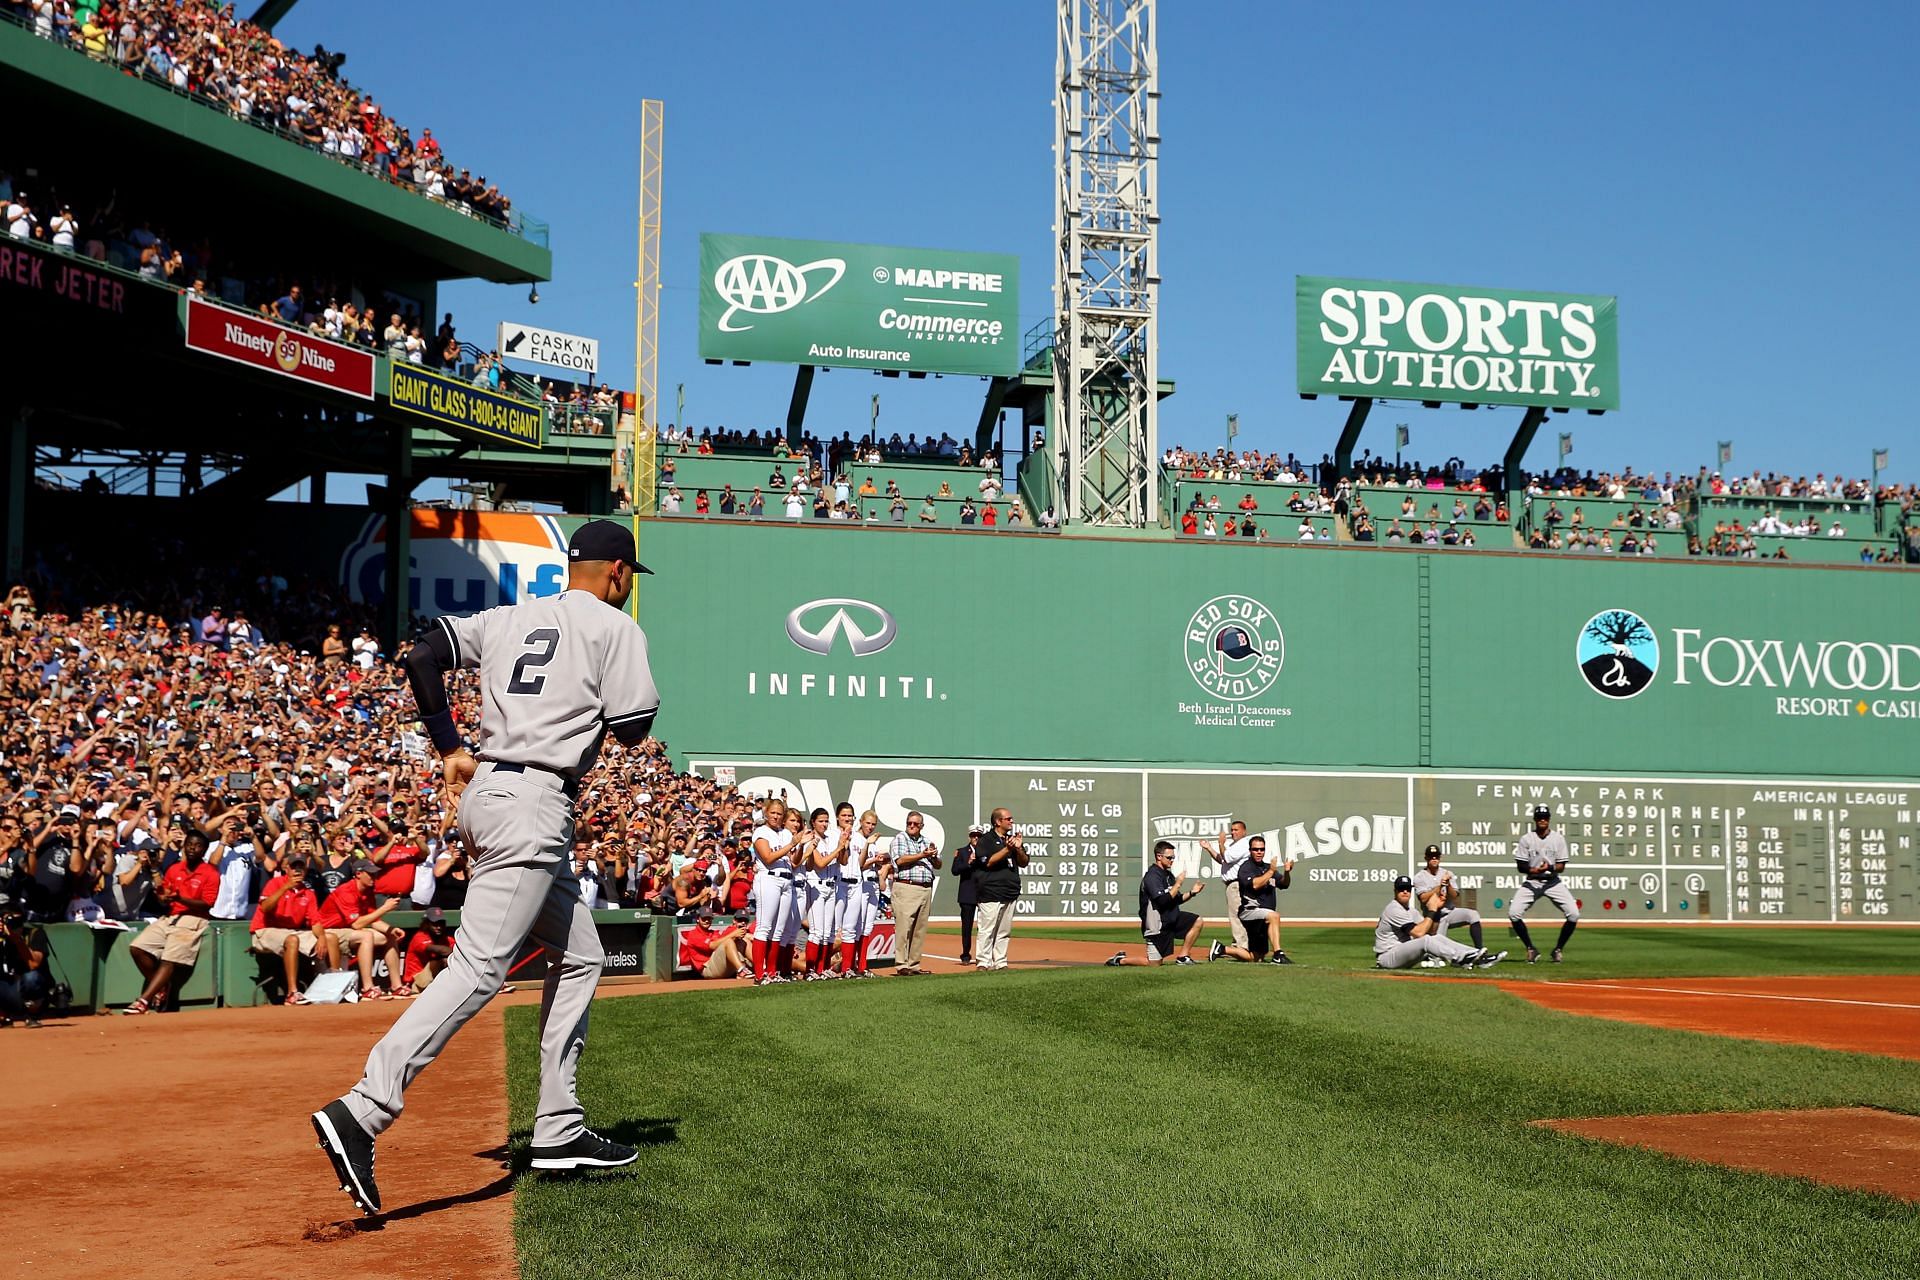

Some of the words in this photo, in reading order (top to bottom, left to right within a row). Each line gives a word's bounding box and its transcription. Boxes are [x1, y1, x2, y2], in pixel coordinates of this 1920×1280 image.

[722, 256, 800, 312] AAA
[895, 267, 1002, 293] MAPFRE
[55, 265, 124, 313] JETER
[879, 308, 1003, 336] Commerce
[1320, 287, 1597, 360] SPORTS
[531, 332, 573, 353] CASK
[907, 332, 998, 345] INSURANCE
[225, 323, 275, 357] Ninety
[302, 346, 335, 372] Nine
[809, 343, 843, 357] Auto
[846, 345, 911, 362] Insurance
[531, 347, 594, 371] FLAGON
[1321, 348, 1596, 396] AUTHORITY
[394, 372, 429, 405] GIANT
[430, 382, 467, 421] GLASS
[468, 398, 508, 431] 1-800-54
[509, 409, 539, 441] GIANT
[1189, 604, 1222, 644] RED
[1228, 599, 1267, 627] SOX
[504, 626, 562, 697] 2
[1193, 639, 1280, 696] SCHOLARS
[749, 672, 933, 699] INFINITI
[1178, 702, 1201, 713] Beth
[1205, 703, 1234, 714] Israel
[1237, 704, 1292, 716] Deaconess
[1776, 697, 1852, 716] RESORT
[1871, 700, 1920, 718] CASI
[1195, 715, 1237, 726] Medical
[1240, 716, 1276, 727] Center
[1028, 778, 1048, 791] AL
[1057, 779, 1095, 792] EAST
[1477, 784, 1579, 799] FENWAY
[1599, 787, 1664, 800] PARK
[1752, 790, 1837, 804] AMERICAN
[1845, 792, 1908, 805] LEAGUE
[1058, 803, 1077, 817] W
[1085, 804, 1094, 817] L
[1101, 804, 1122, 817] GB
[1441, 802, 1451, 815] P
[1644, 805, 1658, 819] 10
[1736, 807, 1746, 820] P
[1794, 808, 1808, 821] IN
[1813, 809, 1823, 821] R
[1839, 808, 1849, 822] P
[1897, 810, 1911, 823] IN
[1059, 824, 1077, 837] 95
[1081, 824, 1098, 838] 66
[1153, 818, 1195, 836] WHO
[1198, 817, 1231, 836] BUT
[1439, 822, 1453, 835] 35
[1472, 822, 1492, 835] NY
[1735, 826, 1748, 839] 53
[1761, 827, 1780, 840] TB
[1861, 829, 1885, 841] LAA
[1024, 843, 1048, 856] ORK
[1059, 843, 1077, 856] 83
[1081, 843, 1098, 857] 78
[1105, 844, 1119, 857] 12
[1457, 841, 1507, 855] BOSTON
[1758, 842, 1785, 854] CLE
[1861, 843, 1886, 855] SEA
[1059, 862, 1077, 876] 83
[1081, 862, 1098, 876] 78
[1105, 863, 1119, 876] 12
[1758, 857, 1785, 869] BAL
[1861, 858, 1887, 871] OAK
[1309, 868, 1359, 882] SINCE
[1362, 868, 1399, 882] 1898
[1759, 871, 1785, 884] TOR
[1861, 873, 1887, 885] TEX
[1027, 881, 1052, 894] BAY
[1059, 881, 1076, 895] 77
[1081, 881, 1098, 895] 84
[1105, 882, 1118, 895] 18
[1460, 875, 1484, 888] BAT
[1598, 877, 1628, 890] OUT
[1760, 886, 1783, 899] MIN
[1866, 888, 1884, 900] KC
[1061, 900, 1075, 914] 71
[1081, 901, 1098, 914] 90
[1103, 901, 1121, 914] 24
[1760, 901, 1785, 914] DET
[1862, 902, 1889, 915] CWS
